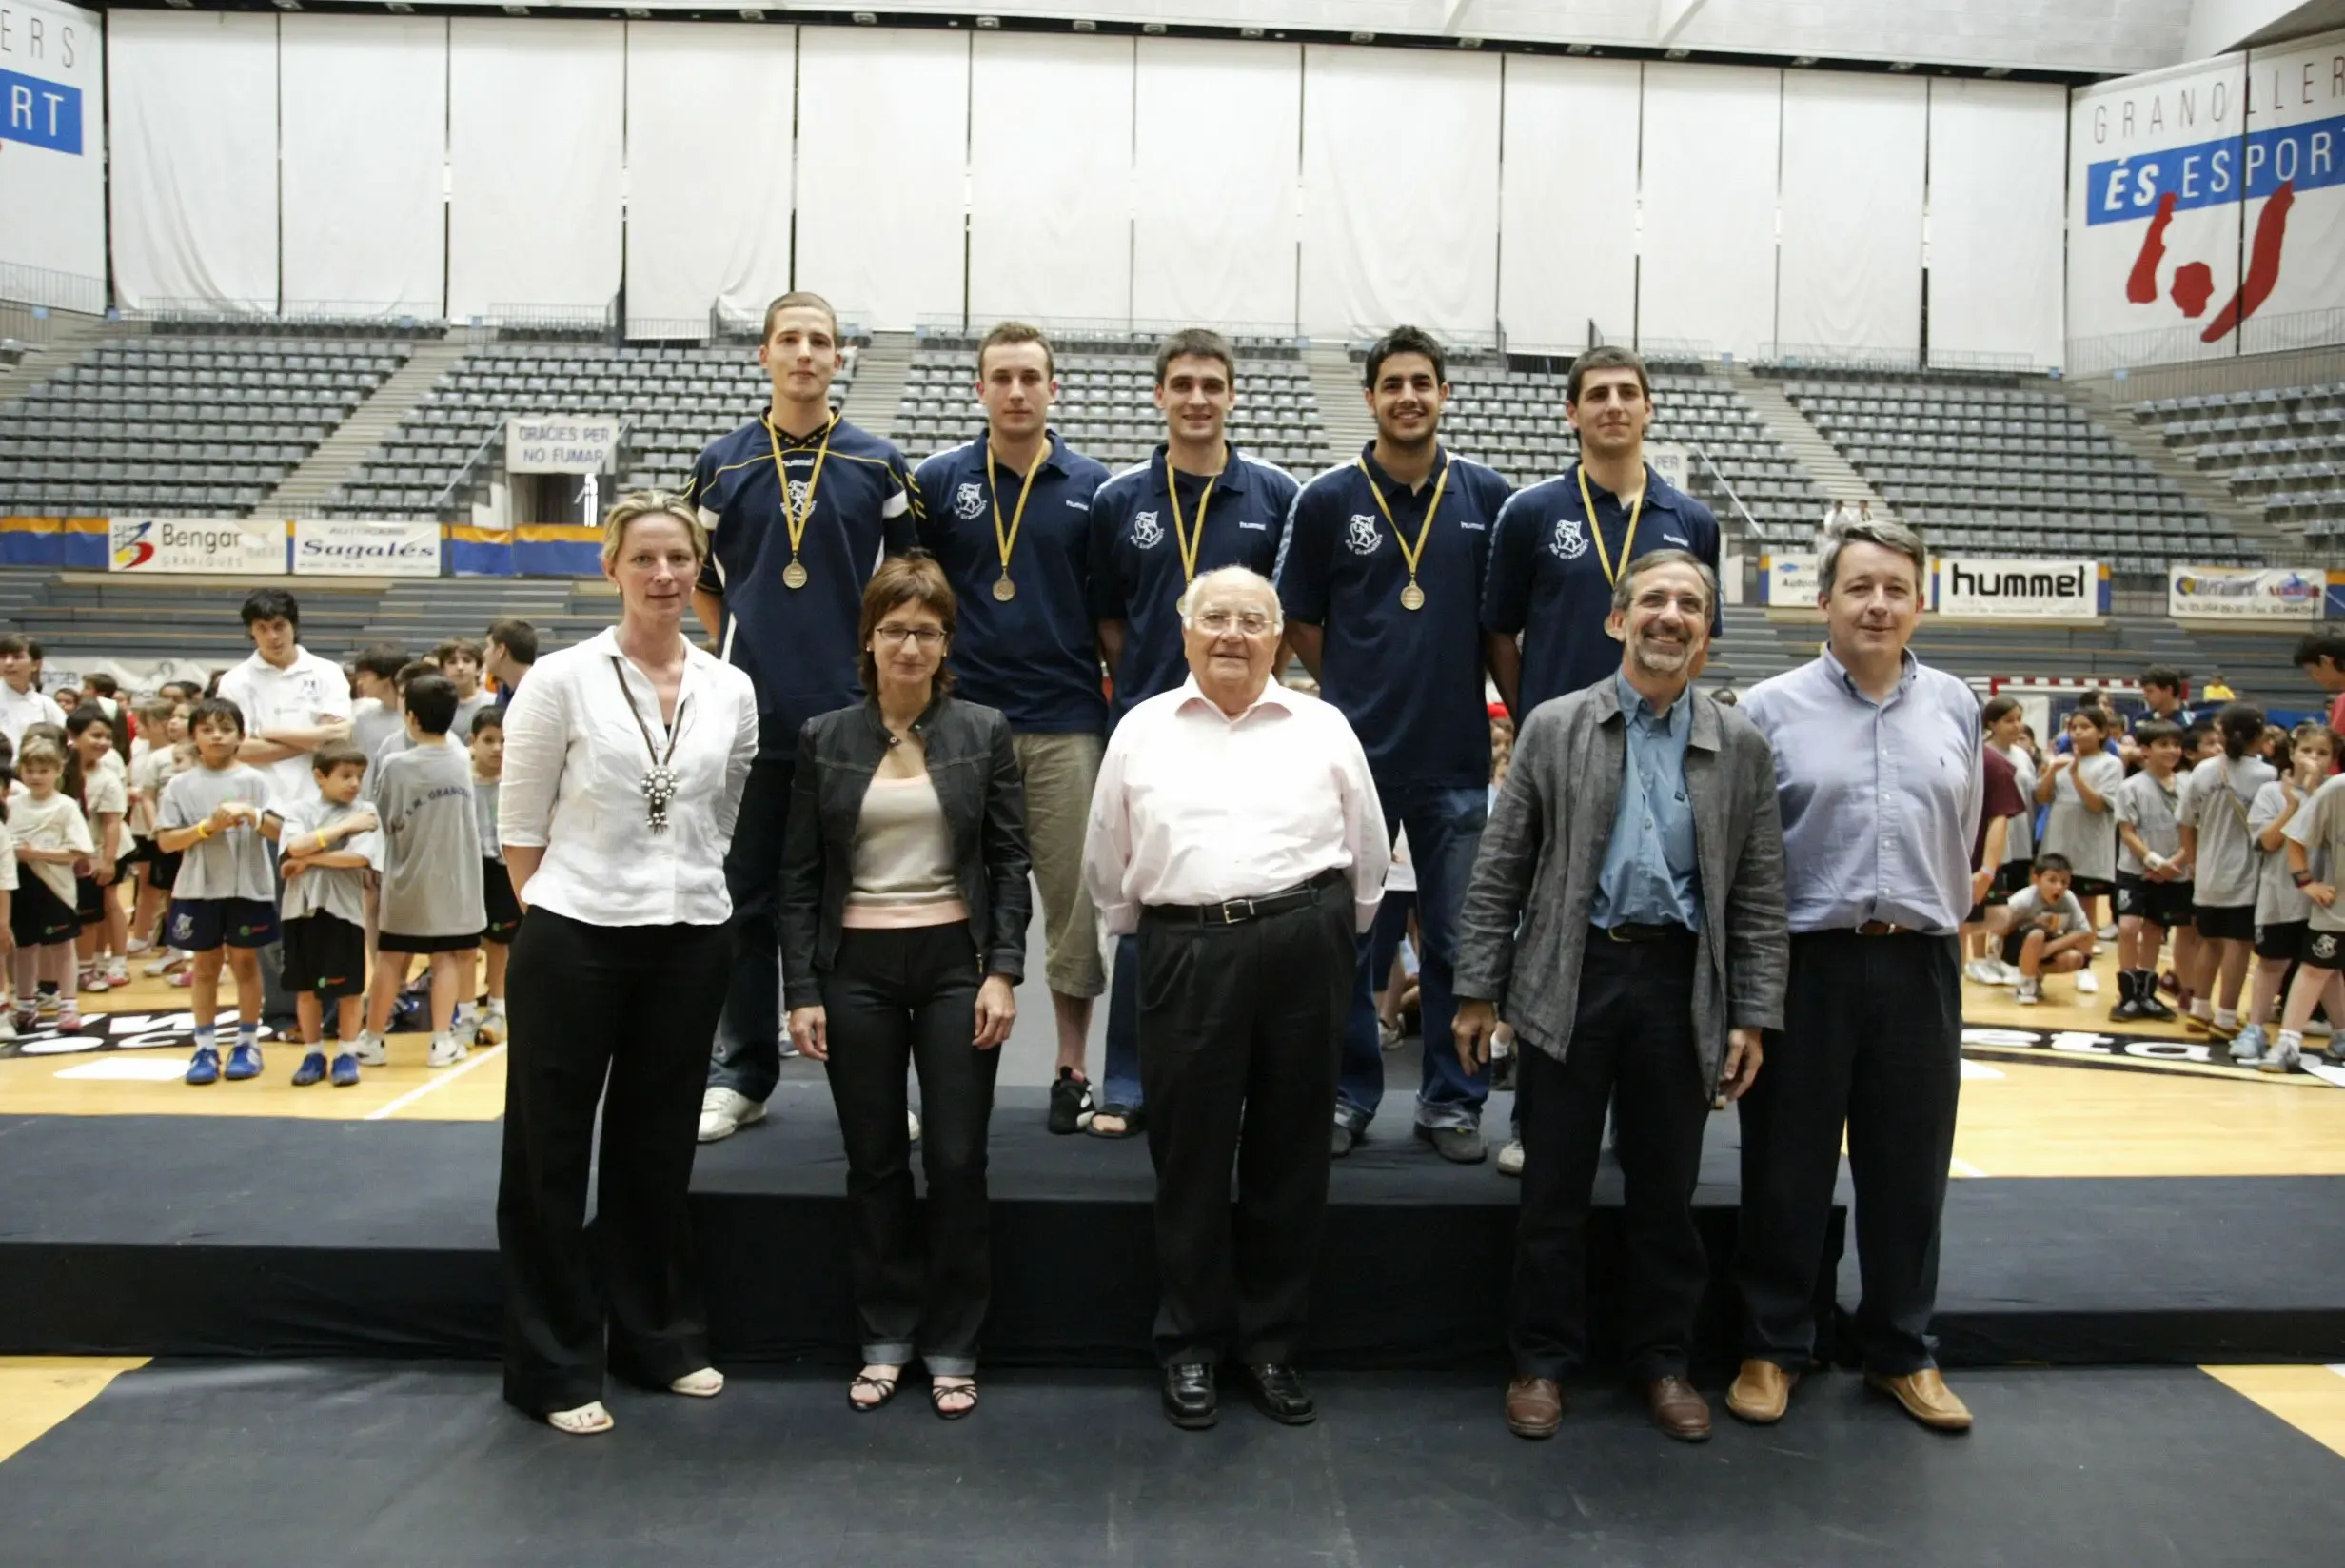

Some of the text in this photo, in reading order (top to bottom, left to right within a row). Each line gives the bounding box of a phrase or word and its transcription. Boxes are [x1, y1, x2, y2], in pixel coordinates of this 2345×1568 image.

[2103, 127, 2345, 211] ÉS ESPOR
[522, 447, 546, 464] NO
[1951, 562, 2085, 598] hummel
